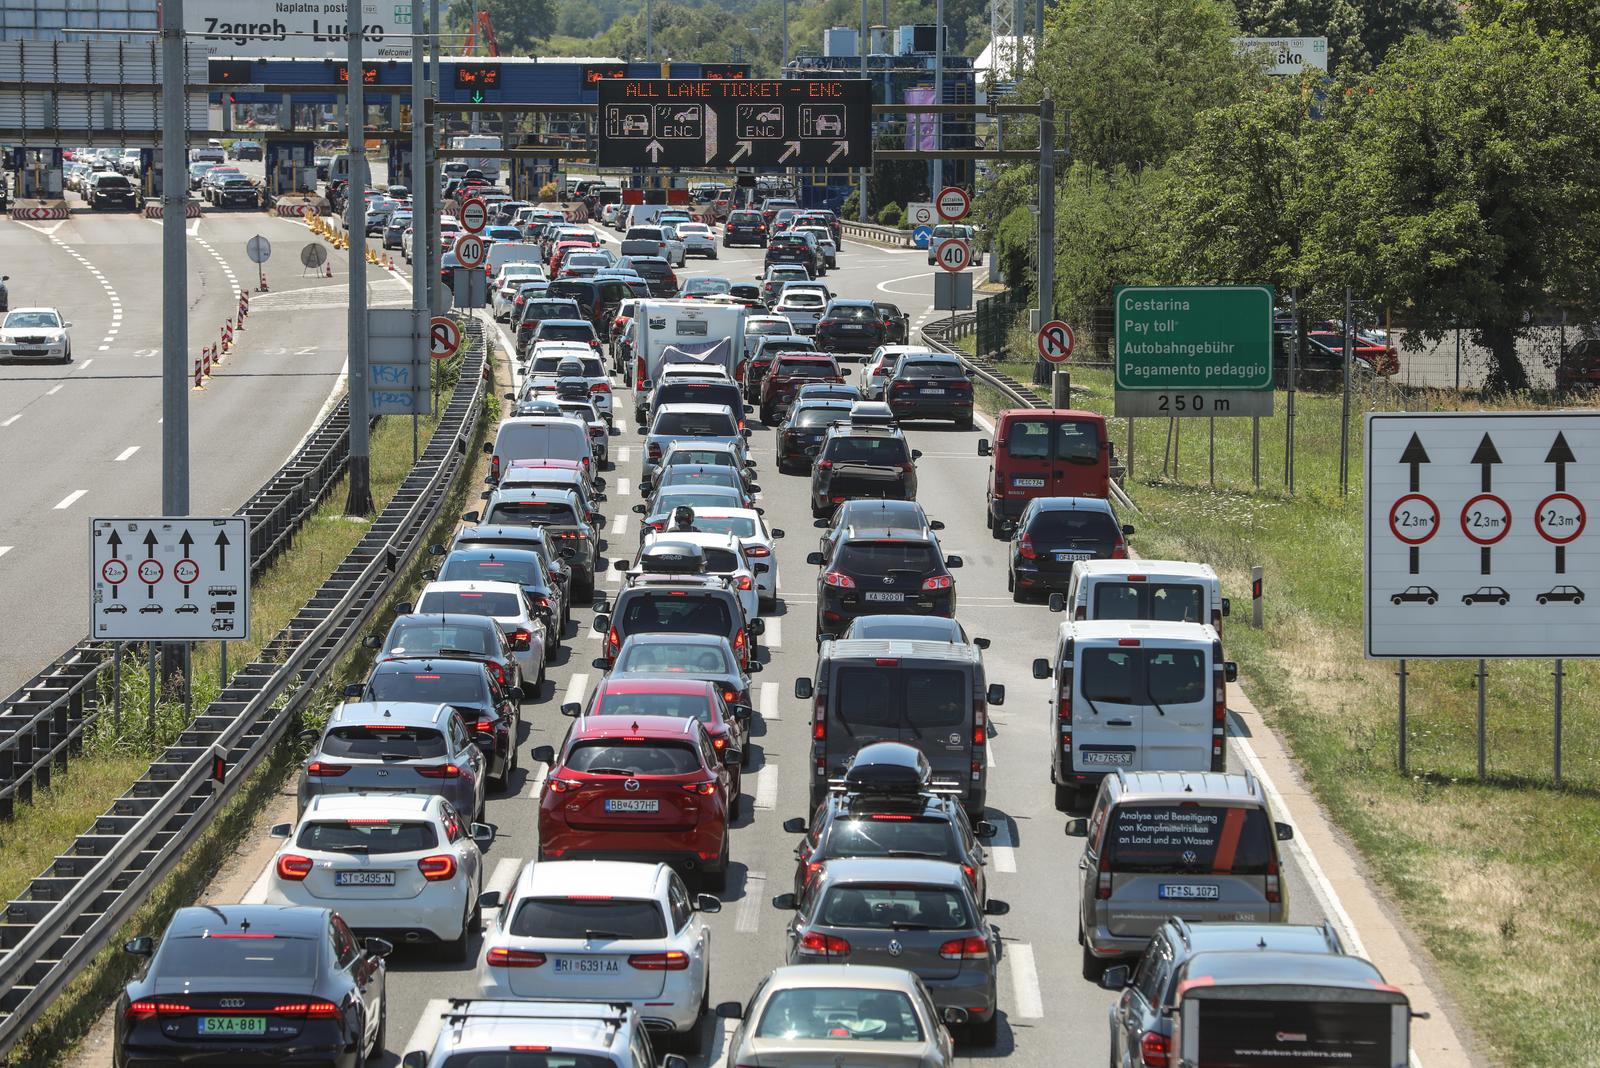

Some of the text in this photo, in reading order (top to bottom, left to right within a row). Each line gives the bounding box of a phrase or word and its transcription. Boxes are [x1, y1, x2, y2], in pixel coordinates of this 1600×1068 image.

[275, 2, 319, 14] Naplatna
[204, 17, 287, 46] Zagreb
[378, 49, 412, 57] Welcome!
[626, 83, 659, 97] ALL
[667, 83, 711, 97] LANE
[720, 83, 783, 97] TICKET
[809, 83, 842, 97] ENC
[664, 126, 692, 137] ENC
[746, 126, 775, 137] ENC
[463, 244, 479, 259] 40
[944, 248, 962, 263] 40
[1125, 299, 1190, 311] Cestarina
[1125, 320, 1175, 335] Pay toll
[1124, 342, 1235, 357] Autobahngebühr
[1125, 363, 1266, 379] Pagamento pedaggio
[1158, 395, 1230, 411] 250 m
[611, 800, 623, 810] BB
[1120, 811, 1218, 824] Analyse und Beseitigung
[1132, 835, 1152, 844] Land
[1154, 836, 1169, 844] und
[1183, 836, 1214, 846] Wasser
[342, 873, 353, 883] ST
[1166, 886, 1217, 897] TF SL 1071
[561, 959, 573, 971] RI
[207, 1018, 262, 1031] SXA-881
